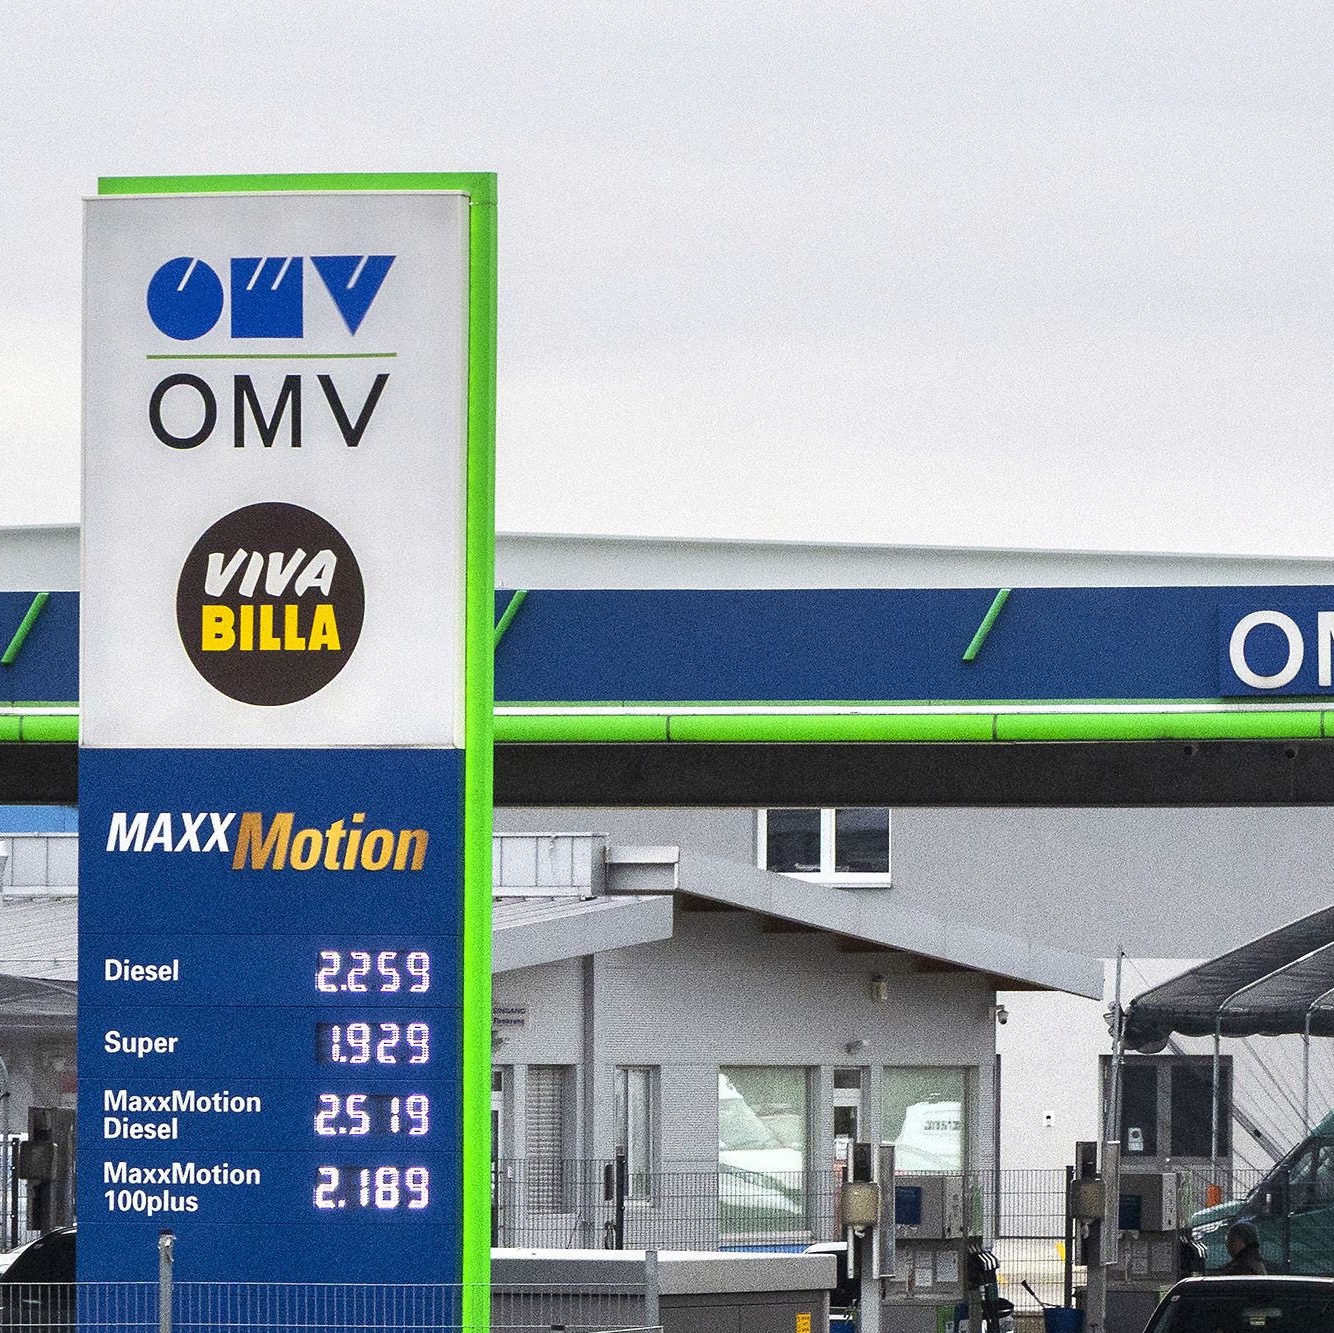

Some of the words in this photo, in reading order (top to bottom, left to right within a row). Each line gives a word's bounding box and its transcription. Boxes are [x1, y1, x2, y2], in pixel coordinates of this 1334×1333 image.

[148, 373, 390, 449] OMV
[204, 548, 338, 598] VIVA
[201, 603, 341, 652] BILLA
[104, 958, 179, 982] Diesel
[315, 951, 430, 993] 2.259
[104, 1030, 179, 1058] Super
[331, 1022, 430, 1064] 1.929
[104, 1089, 261, 1113] MaxxMotion
[104, 1116, 178, 1140] Diesel
[104, 1161, 261, 1185] MaxxMotion
[314, 1166, 430, 1210] 2.189
[104, 1189, 199, 1217] 100plus
